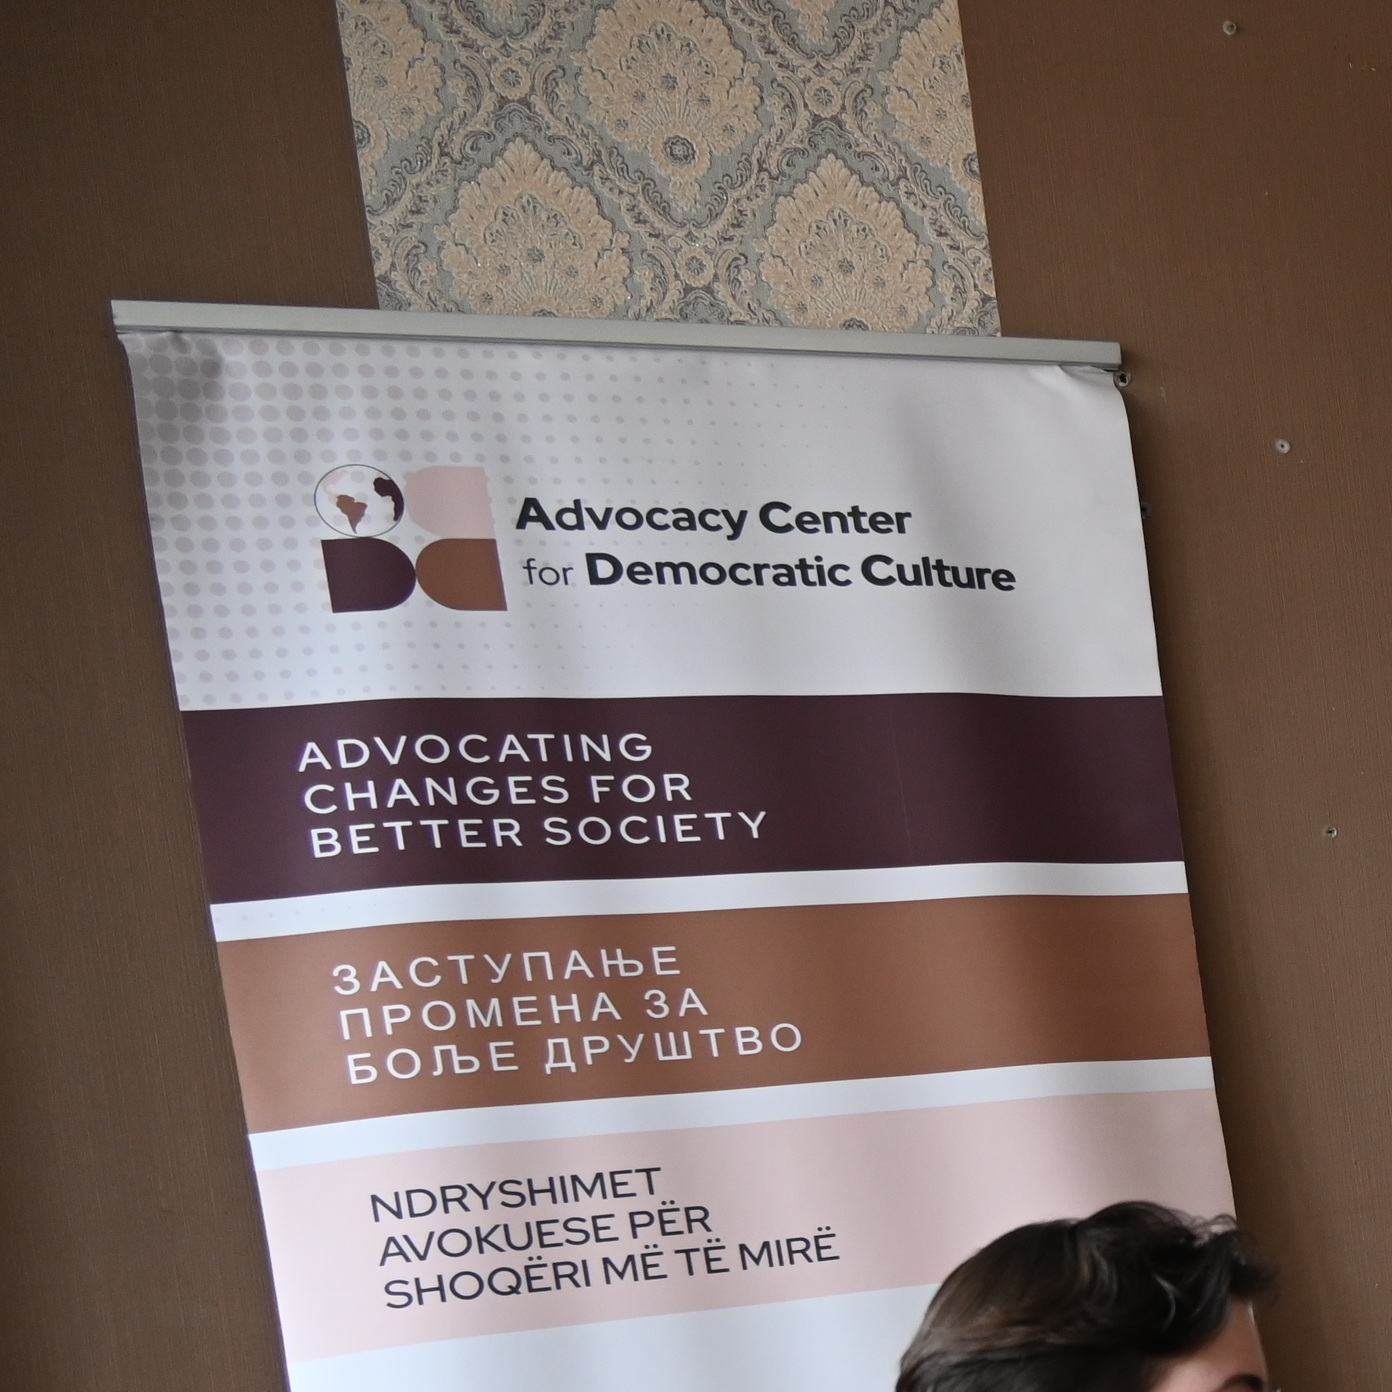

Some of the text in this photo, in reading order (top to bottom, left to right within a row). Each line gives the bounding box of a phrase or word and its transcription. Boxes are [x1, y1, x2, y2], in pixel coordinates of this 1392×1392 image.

[516, 497, 912, 541] Advocacy Center
[523, 553, 1016, 591] for Democratic Culture
[299, 733, 651, 772] ADVOCATING
[304, 774, 691, 814] CHANGES FOR
[311, 812, 765, 858] BETTER SOCIETY
[331, 947, 680, 995] ЗАСТУПАЊЕ
[338, 988, 708, 1041] ПРОМЕНА ЗА
[347, 1023, 801, 1084] БОЉЕ ДРУШТВО
[371, 1167, 661, 1222] NDRYSHIMET
[380, 1200, 712, 1266] AVOKUESE PËR
[385, 1226, 840, 1308] SHOQËRI MË TË MIRË
